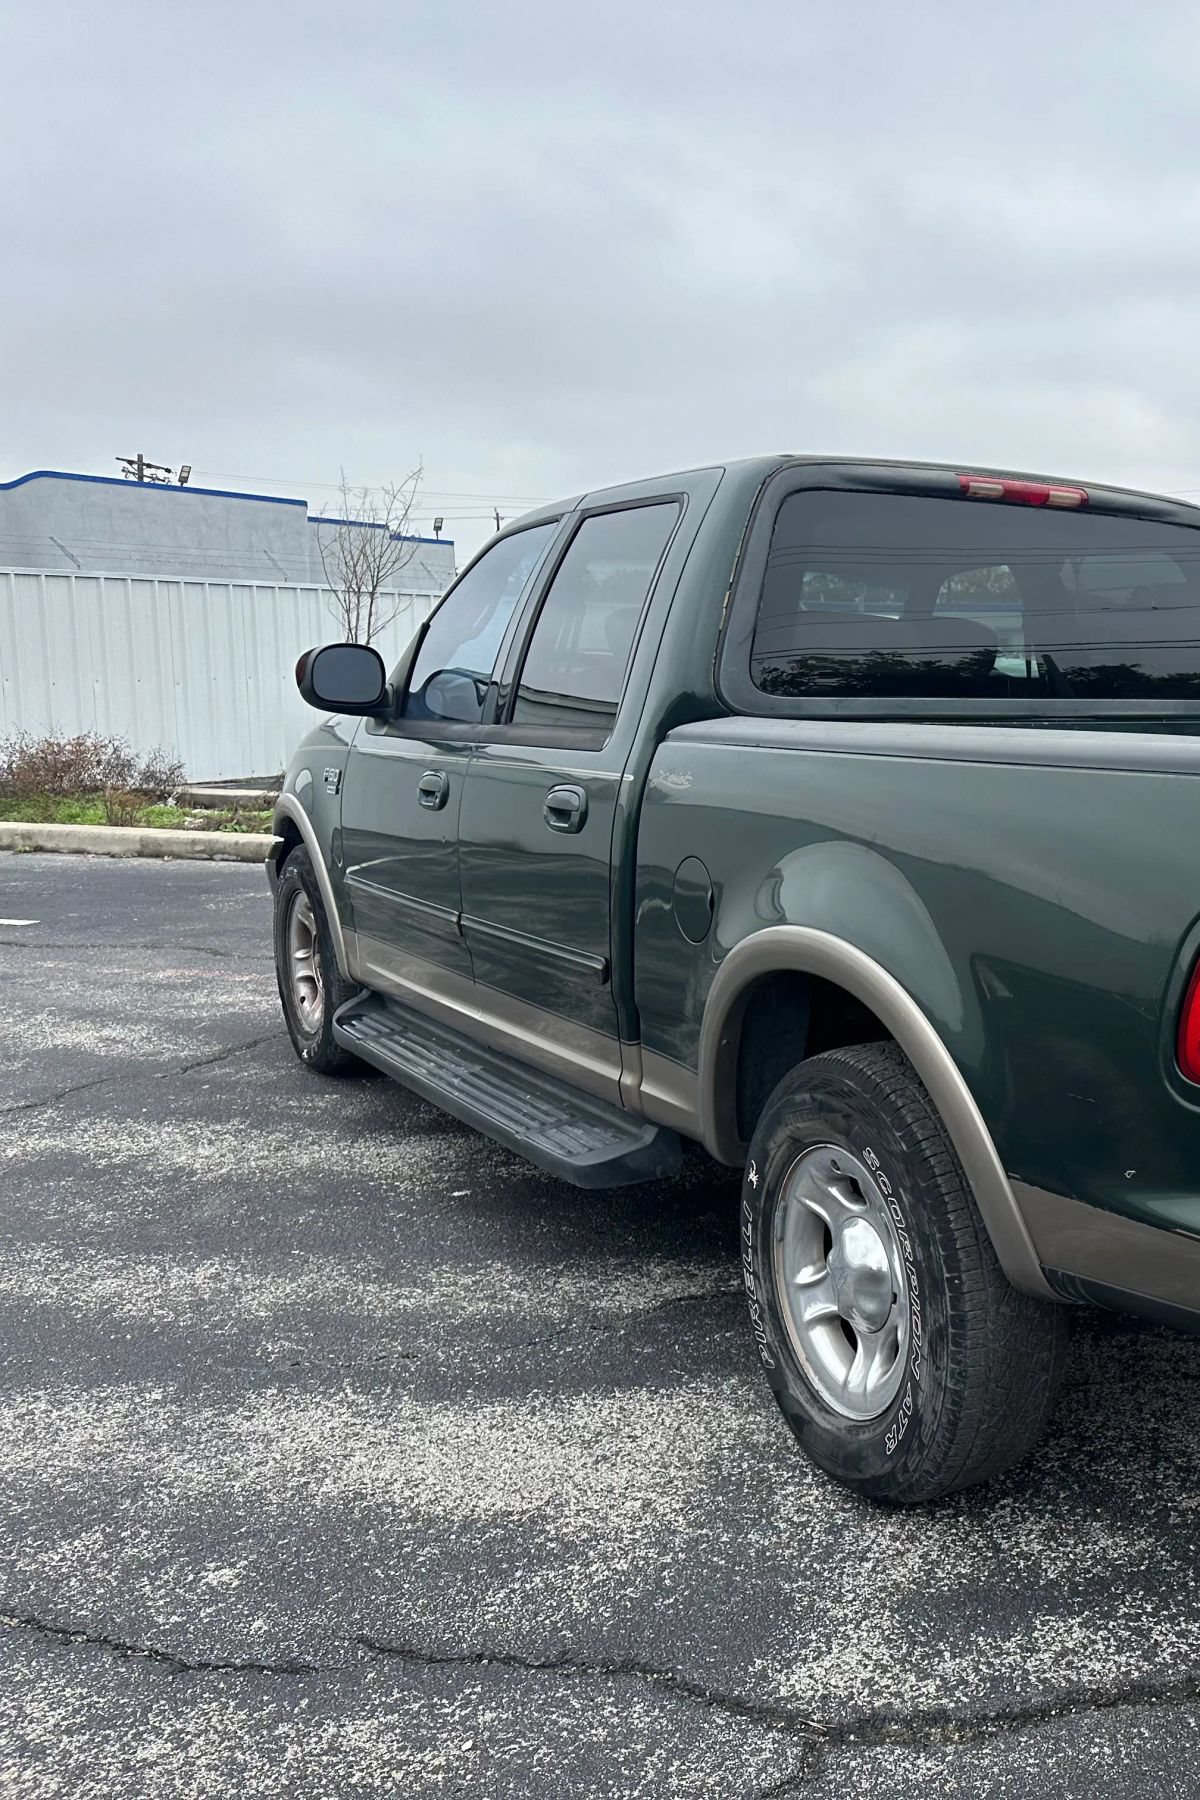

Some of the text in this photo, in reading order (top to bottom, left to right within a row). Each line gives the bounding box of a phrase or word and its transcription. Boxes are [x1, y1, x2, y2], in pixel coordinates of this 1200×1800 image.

[740, 1201, 776, 1370] PIRELLI
[862, 1147, 921, 1455] SCORPION ATR
